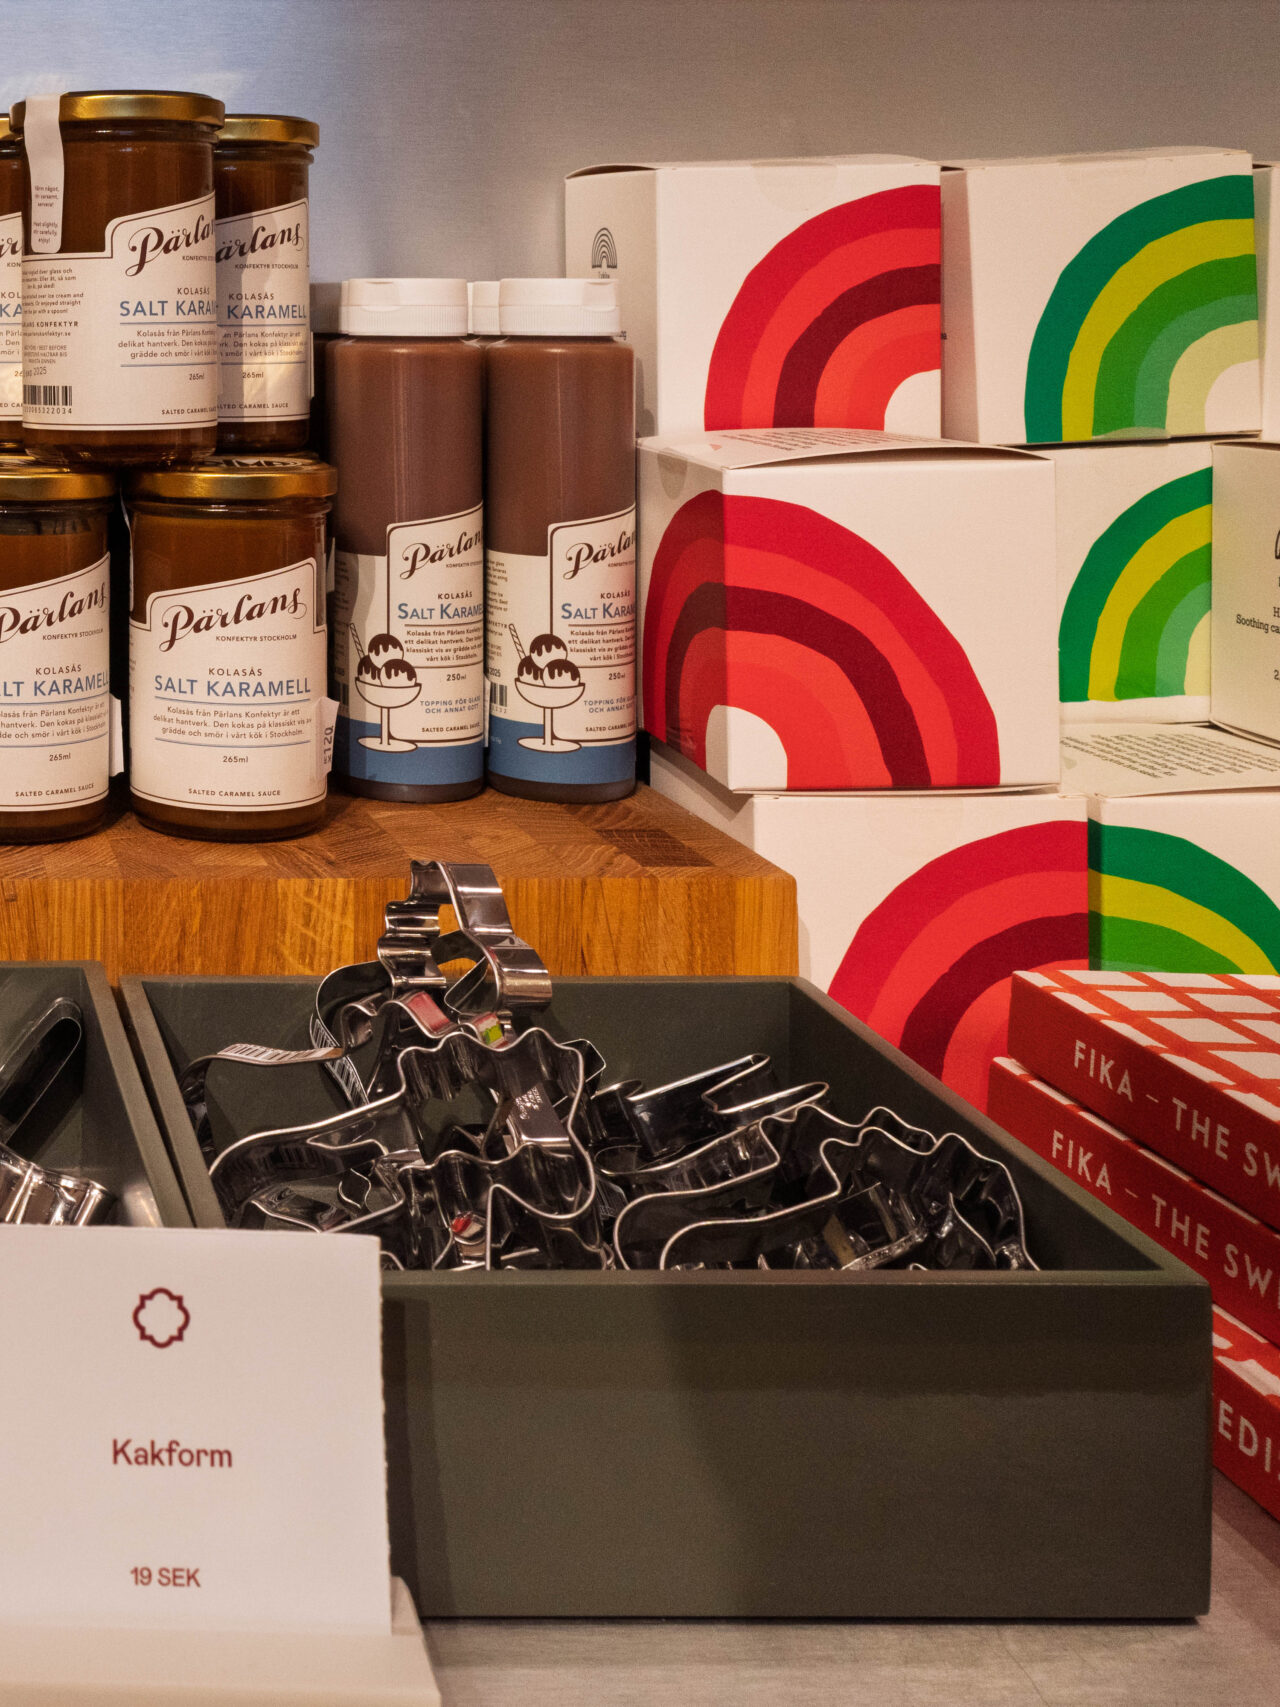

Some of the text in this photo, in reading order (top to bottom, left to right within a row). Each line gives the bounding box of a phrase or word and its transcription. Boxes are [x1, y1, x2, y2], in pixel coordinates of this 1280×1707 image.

[216, 223, 304, 263] ärlans
[177, 287, 210, 295] KOLASÅS
[229, 292, 274, 300] KOLASÅS
[120, 300, 216, 316] SALT KARA
[437, 591, 473, 600] KOLASÅS
[600, 590, 630, 599] KOLASÅS
[159, 588, 307, 652] Pärlans
[1236, 614, 1280, 634] Soothing ca
[43, 632, 78, 641] KONFEKTYR
[36, 664, 82, 675] KOLASÅS
[208, 666, 263, 677] KOLASÅS
[155, 675, 311, 697] SALT KARAMELL
[167, 706, 194, 716] Kolasås
[196, 709, 211, 717] från
[214, 710, 242, 719] Pärlans
[245, 709, 281, 719] Konfektyr
[290, 708, 300, 716] ett
[153, 714, 174, 724] delikat
[231, 721, 254, 729] kokas
[256, 721, 267, 730] på
[268, 719, 296, 728] klassiskt
[161, 727, 186, 736] grädde
[188, 729, 202, 737] och
[204, 730, 223, 738] smör
[231, 731, 246, 739] vårt
[249, 730, 263, 739] kök
[270, 729, 304, 738] Stockholm.
[49, 753, 71, 761] 265ml
[222, 755, 249, 763] 265ml
[46, 787, 76, 796] CARAMEL
[78, 783, 95, 791] SAUCE
[188, 788, 215, 796] SALTED
[1073, 1039, 1133, 1102] FIKA
[1172, 1098, 1230, 1161] THE
[1051, 1130, 1112, 1196] FIKA
[1152, 1194, 1210, 1260] THE
[1224, 1243, 1280, 1310] SW
[112, 1438, 234, 1468] Kakform
[130, 1567, 201, 1588] 19 SEK
